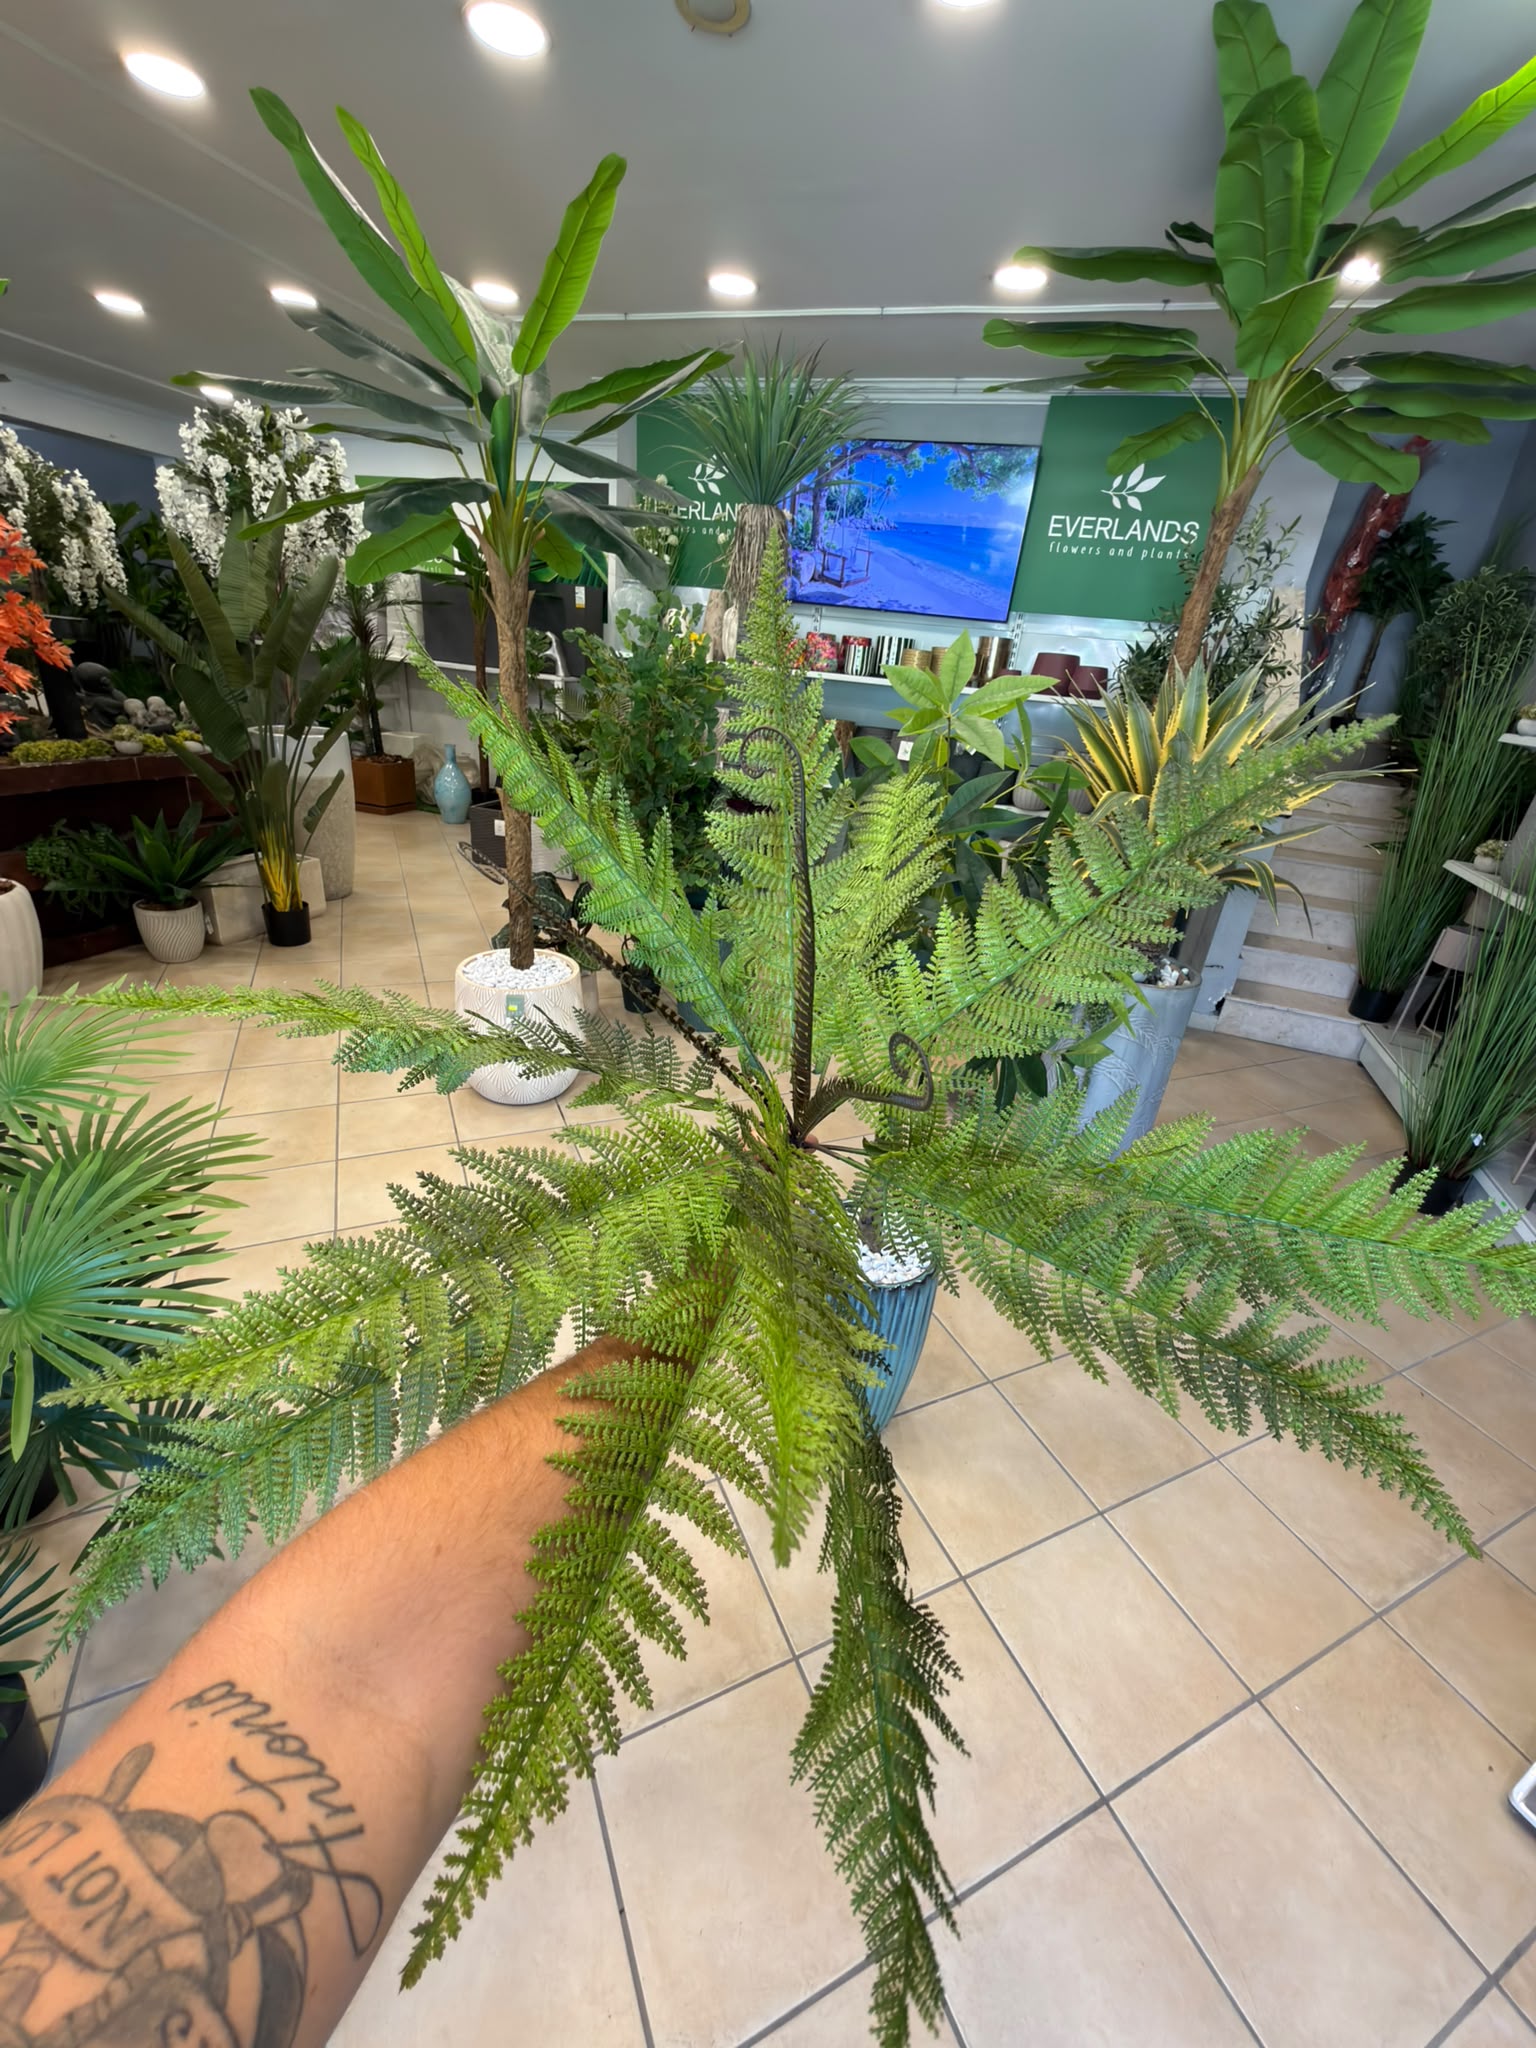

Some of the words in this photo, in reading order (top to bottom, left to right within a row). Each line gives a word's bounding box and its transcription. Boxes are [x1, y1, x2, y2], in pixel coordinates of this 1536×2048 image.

[676, 500, 739, 521] ERLAN
[1047, 514, 1200, 545] EVERLANDS
[1049, 541, 1101, 555] flowers
[1109, 546, 1134, 557] and
[169, 1680, 384, 1960] Antonio
[44, 1850, 151, 1949] NOT
